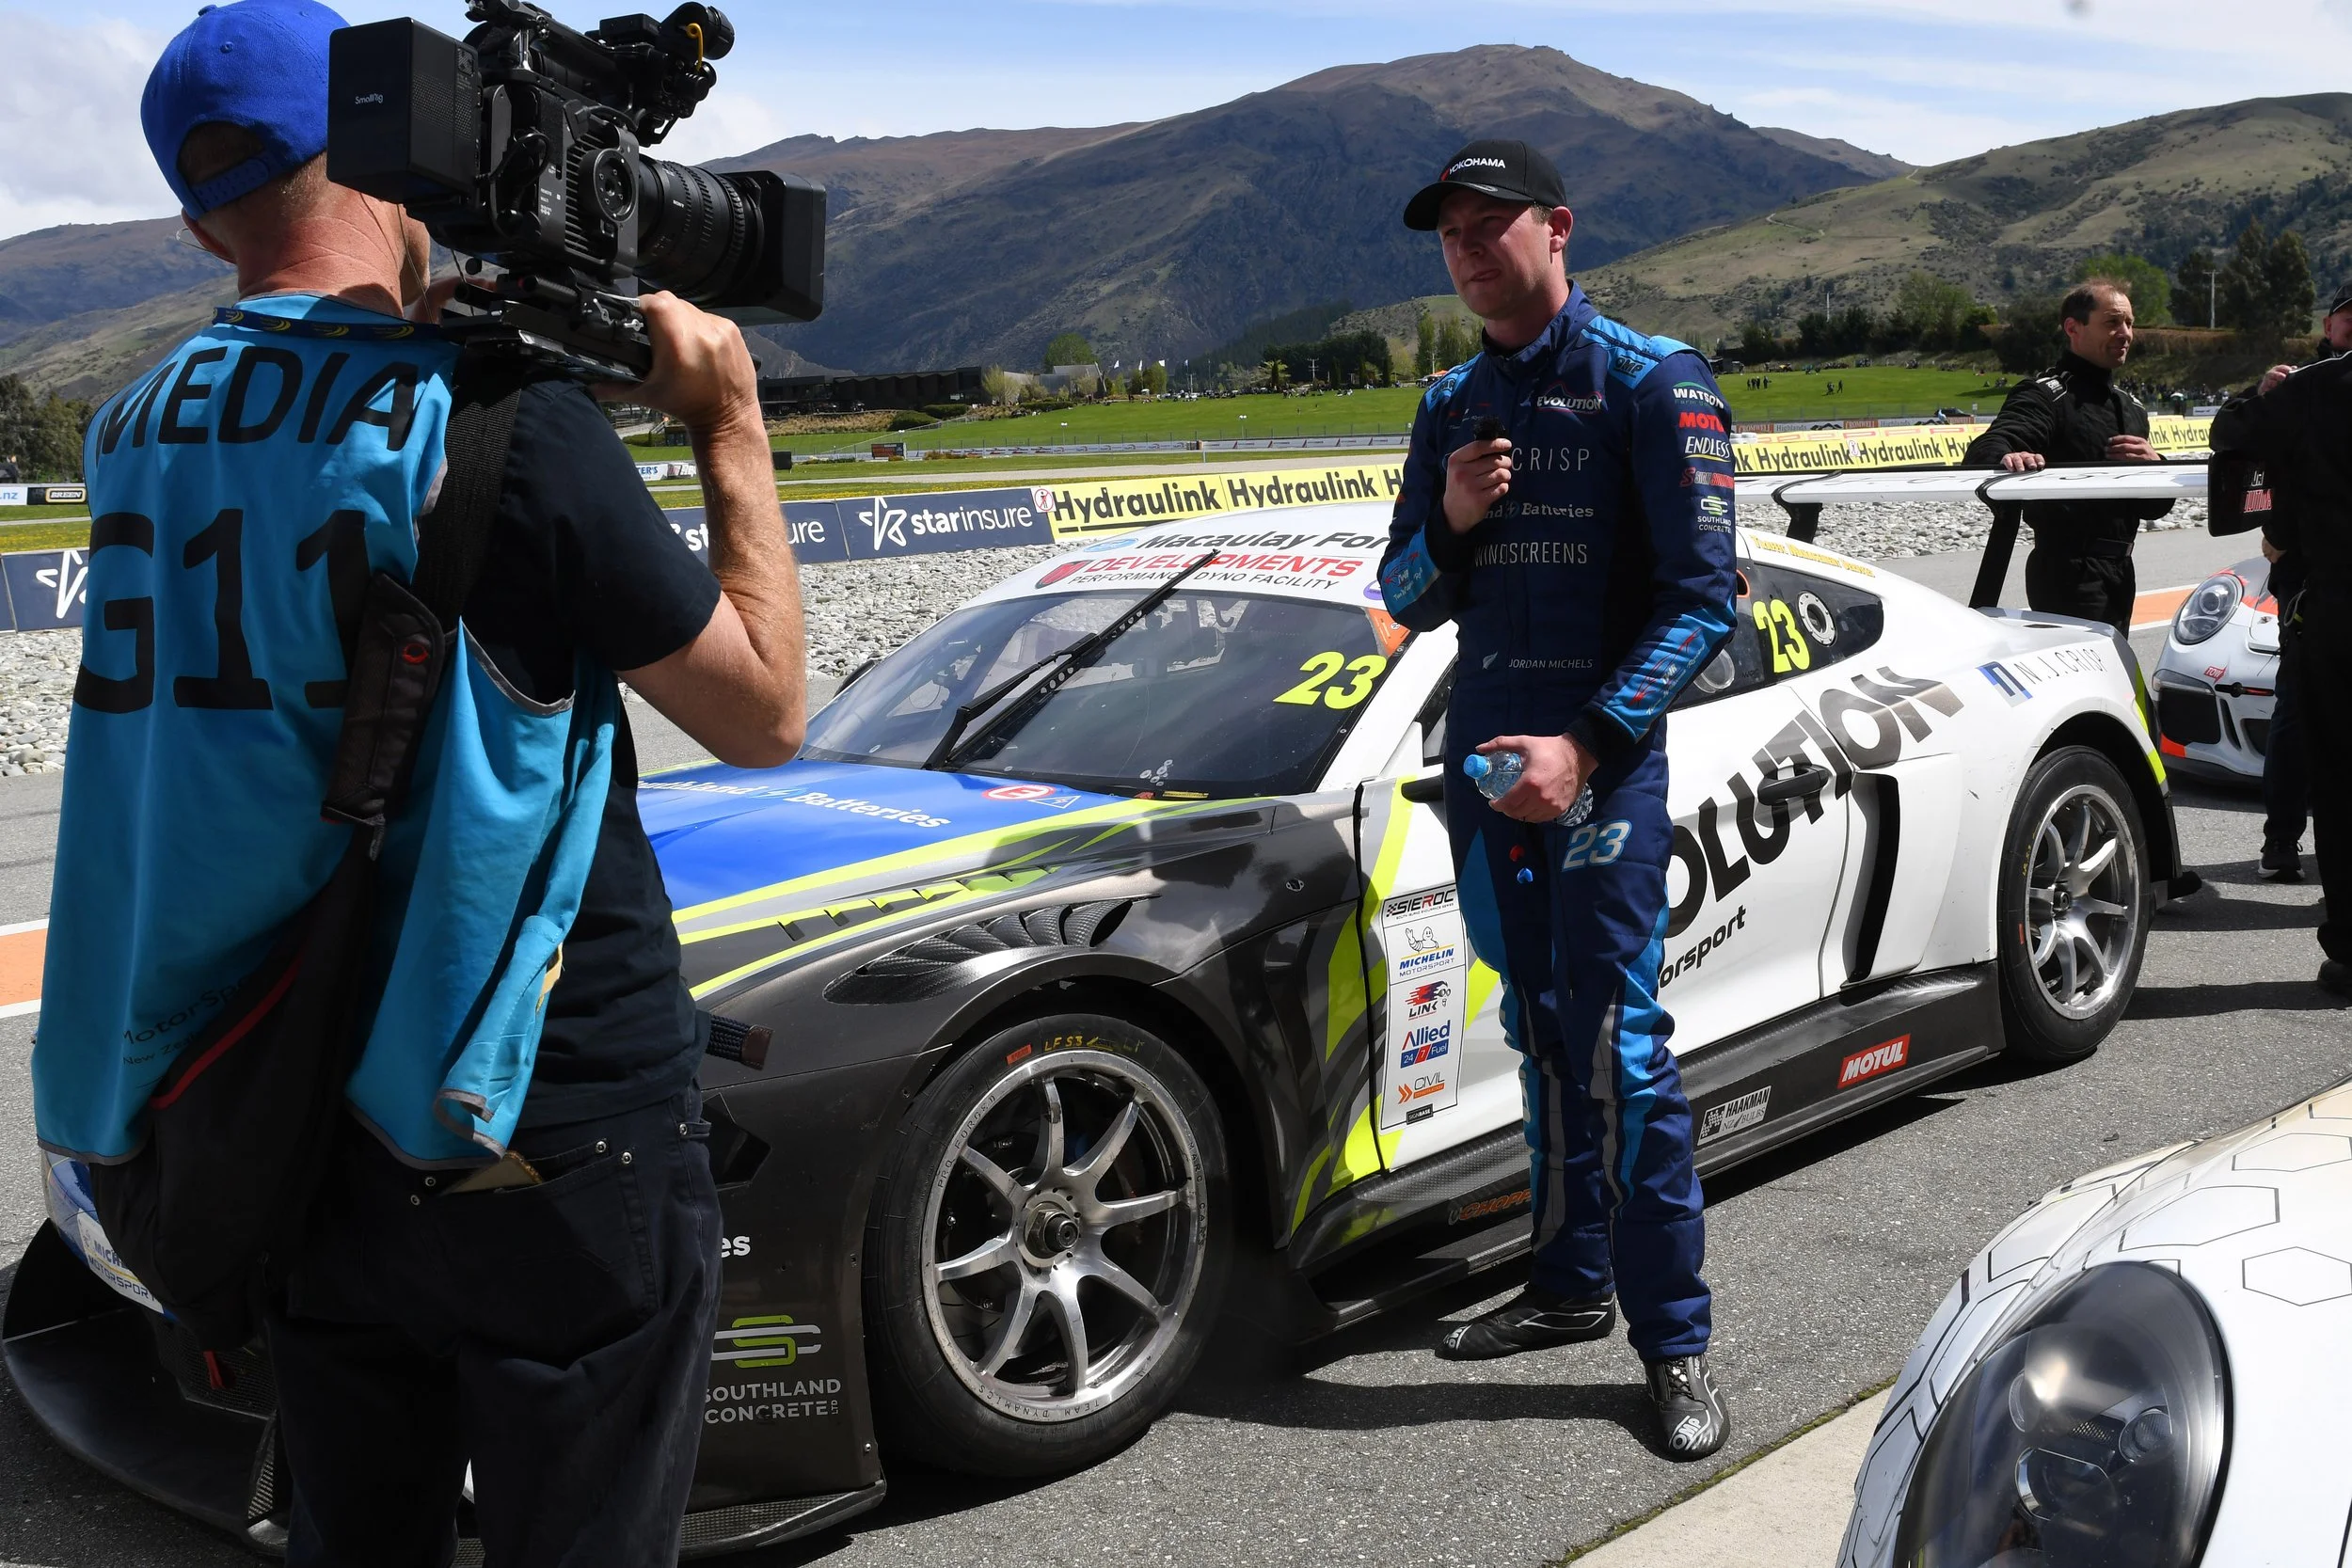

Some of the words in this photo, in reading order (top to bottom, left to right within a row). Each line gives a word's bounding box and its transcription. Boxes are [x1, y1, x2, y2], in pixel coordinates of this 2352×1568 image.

[1450, 157, 1506, 174] YOKOHAMA
[96, 345, 420, 468] MEDIA
[1536, 395, 1601, 411] EVOLUTION
[1673, 388, 1724, 410] WATSON
[1678, 412, 1725, 433] MOTU
[1512, 447, 1590, 470] CRISP
[1685, 436, 1730, 459] ENDLESS
[1756, 437, 1851, 472] Hydraulink
[1859, 436, 1943, 465] Hydraulink
[1227, 469, 1379, 508] Hydraulink
[1052, 481, 1222, 524] Hydraulink
[1521, 502, 1595, 517] Batteries
[910, 505, 1033, 535] starinsure
[1697, 516, 1732, 527] SOUTHLAND
[1698, 524, 1732, 534] CONCRETE
[1136, 531, 1319, 551] Macaulay
[1316, 531, 1391, 550] For
[1475, 542, 1588, 567] WINDSCREENS
[1193, 572, 1237, 582] DYNO
[1243, 573, 1340, 590] FACILITY
[1753, 599, 1810, 673] 23
[1509, 659, 1546, 669] JORDAN
[1549, 659, 1593, 669] MICHELS
[2206, 667, 2223, 678] TOW
[1273, 651, 1388, 709] 23
[784, 791, 951, 829] Batteries
[1666, 666, 1965, 939] OLUTION
[1562, 819, 1632, 871] 23
[1392, 889, 1456, 916] SIEROC
[1399, 948, 1454, 970] MICHELIN
[1659, 905, 1746, 990] orsport
[1399, 958, 1454, 977] MOTORSPORT
[1408, 1001, 1438, 1018] LINK
[1402, 1020, 1451, 1051] Allied
[1404, 1053, 1414, 1065] 24
[1421, 1050, 1426, 1059] 7
[1431, 1042, 1448, 1055] Fuel
[1842, 1041, 1904, 1082] MOTUL
[1414, 1072, 1446, 1090] CIVIL
[1725, 1087, 1770, 1118] HAAKMAN
[1722, 1119, 1735, 1132] NZ
[1741, 1107, 1766, 1124] BULBS
[705, 1400, 829, 1424] CONCRETE
[831, 1400, 839, 1415] LTD
[1672, 1418, 1702, 1449] OMP
